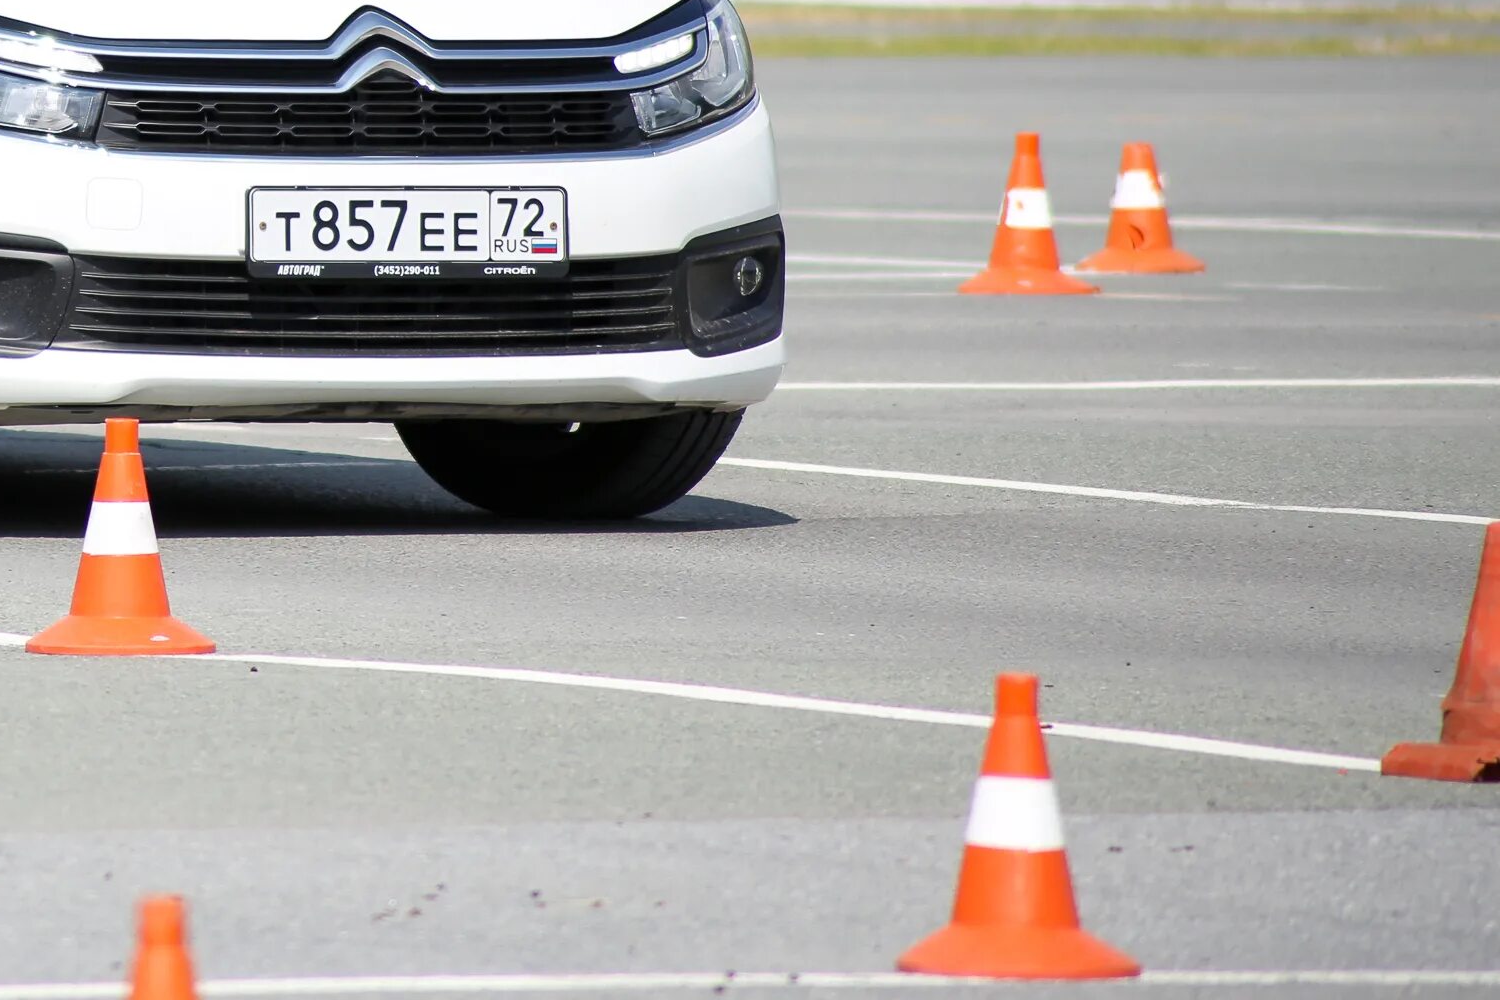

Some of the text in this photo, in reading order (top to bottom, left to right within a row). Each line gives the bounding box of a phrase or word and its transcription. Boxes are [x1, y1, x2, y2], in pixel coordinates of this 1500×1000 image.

[497, 197, 544, 237] 72
[494, 239, 529, 253] RUS
[277, 264, 324, 277] АВТОГРАД
[373, 265, 440, 277] (3452)290-011
